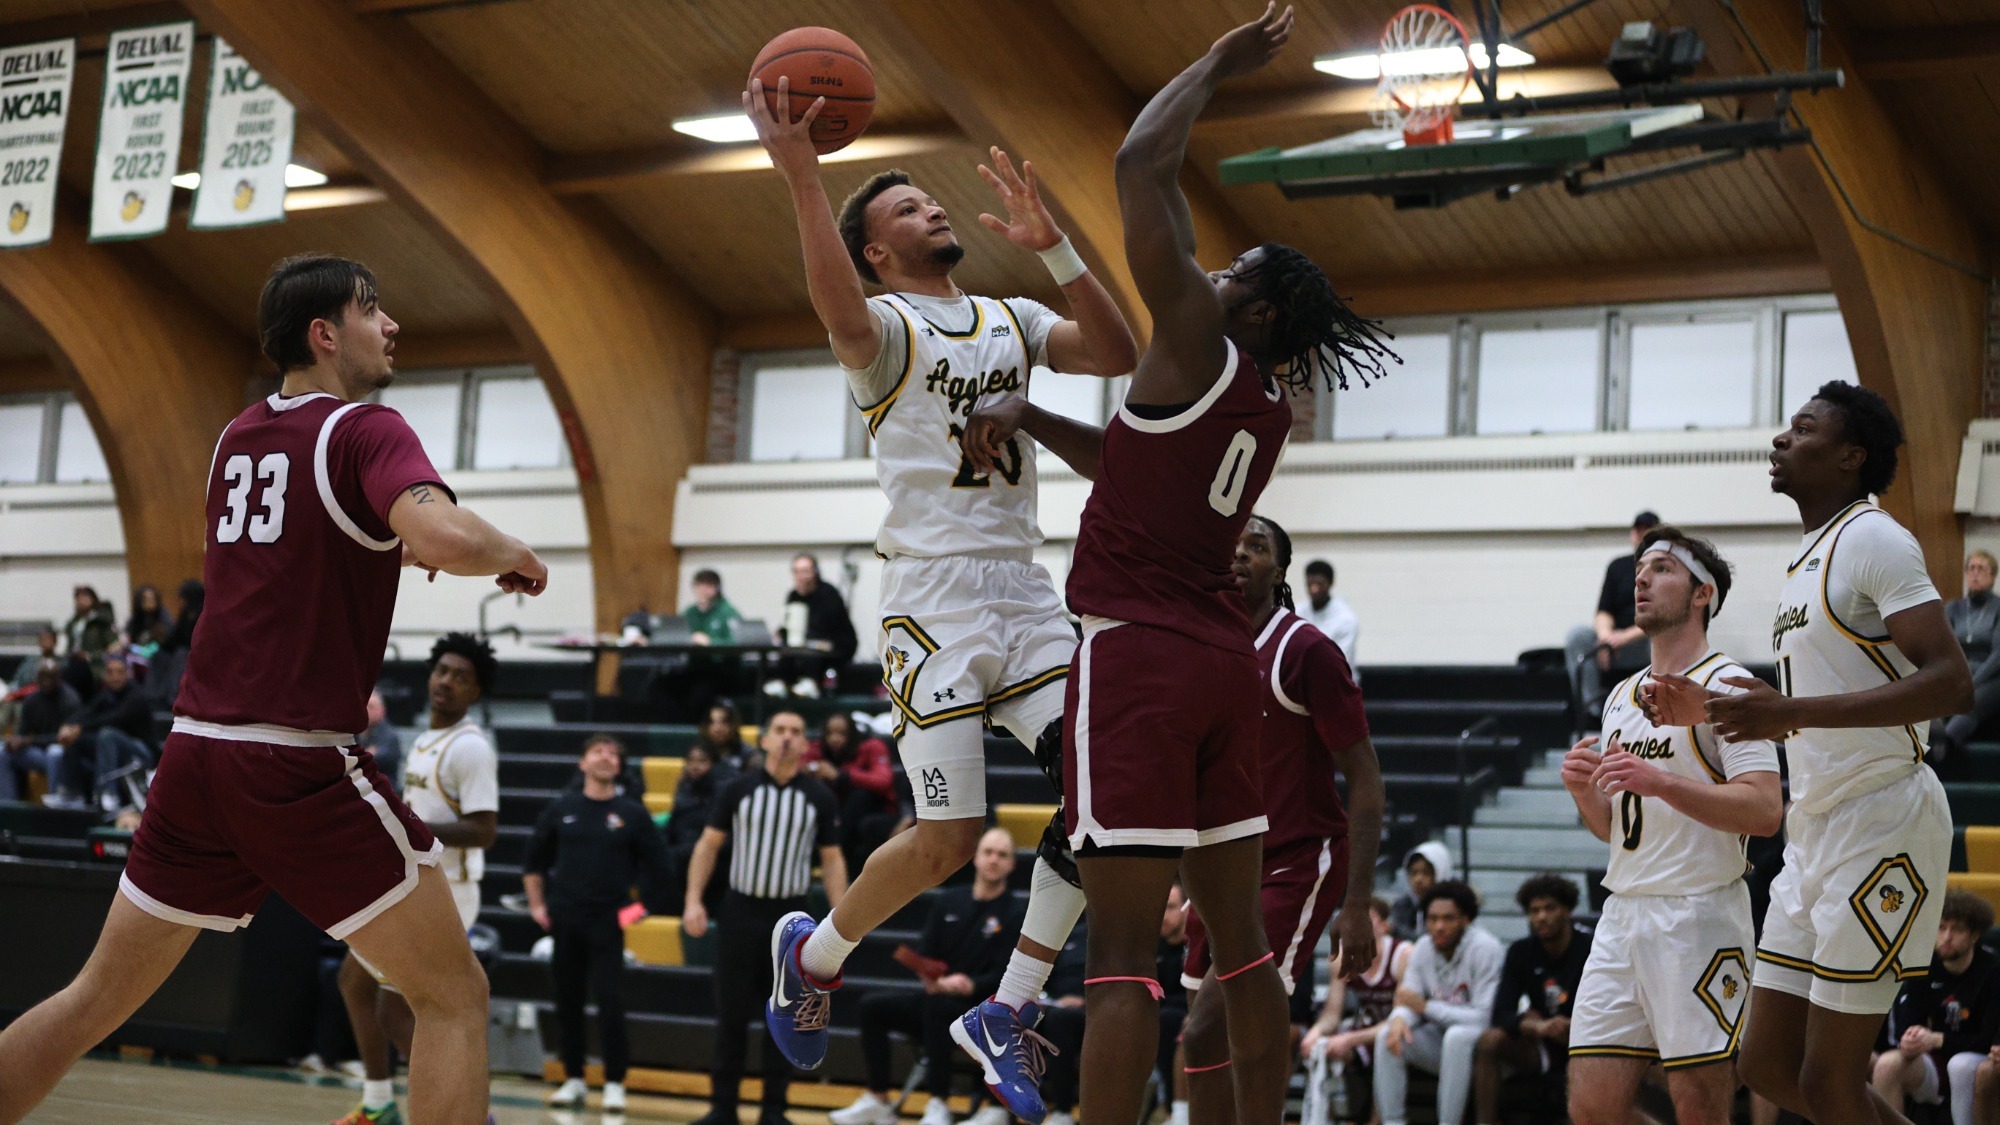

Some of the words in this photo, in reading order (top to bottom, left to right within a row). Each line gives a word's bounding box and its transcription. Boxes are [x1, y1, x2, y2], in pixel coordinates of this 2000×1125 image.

[116, 33, 184, 60] DELVAL
[2, 49, 67, 76] DELVAL
[110, 75, 180, 108] NCAA
[221, 65, 265, 95] NC
[0, 90, 62, 124] NCAA
[111, 152, 166, 181] 2023
[221, 138, 275, 169] 2025
[1, 157, 50, 186] 2022
[926, 358, 1022, 417] Aggies
[1208, 428, 1257, 518] 0
[216, 452, 290, 544] 33
[926, 799, 950, 807] HOOPS
